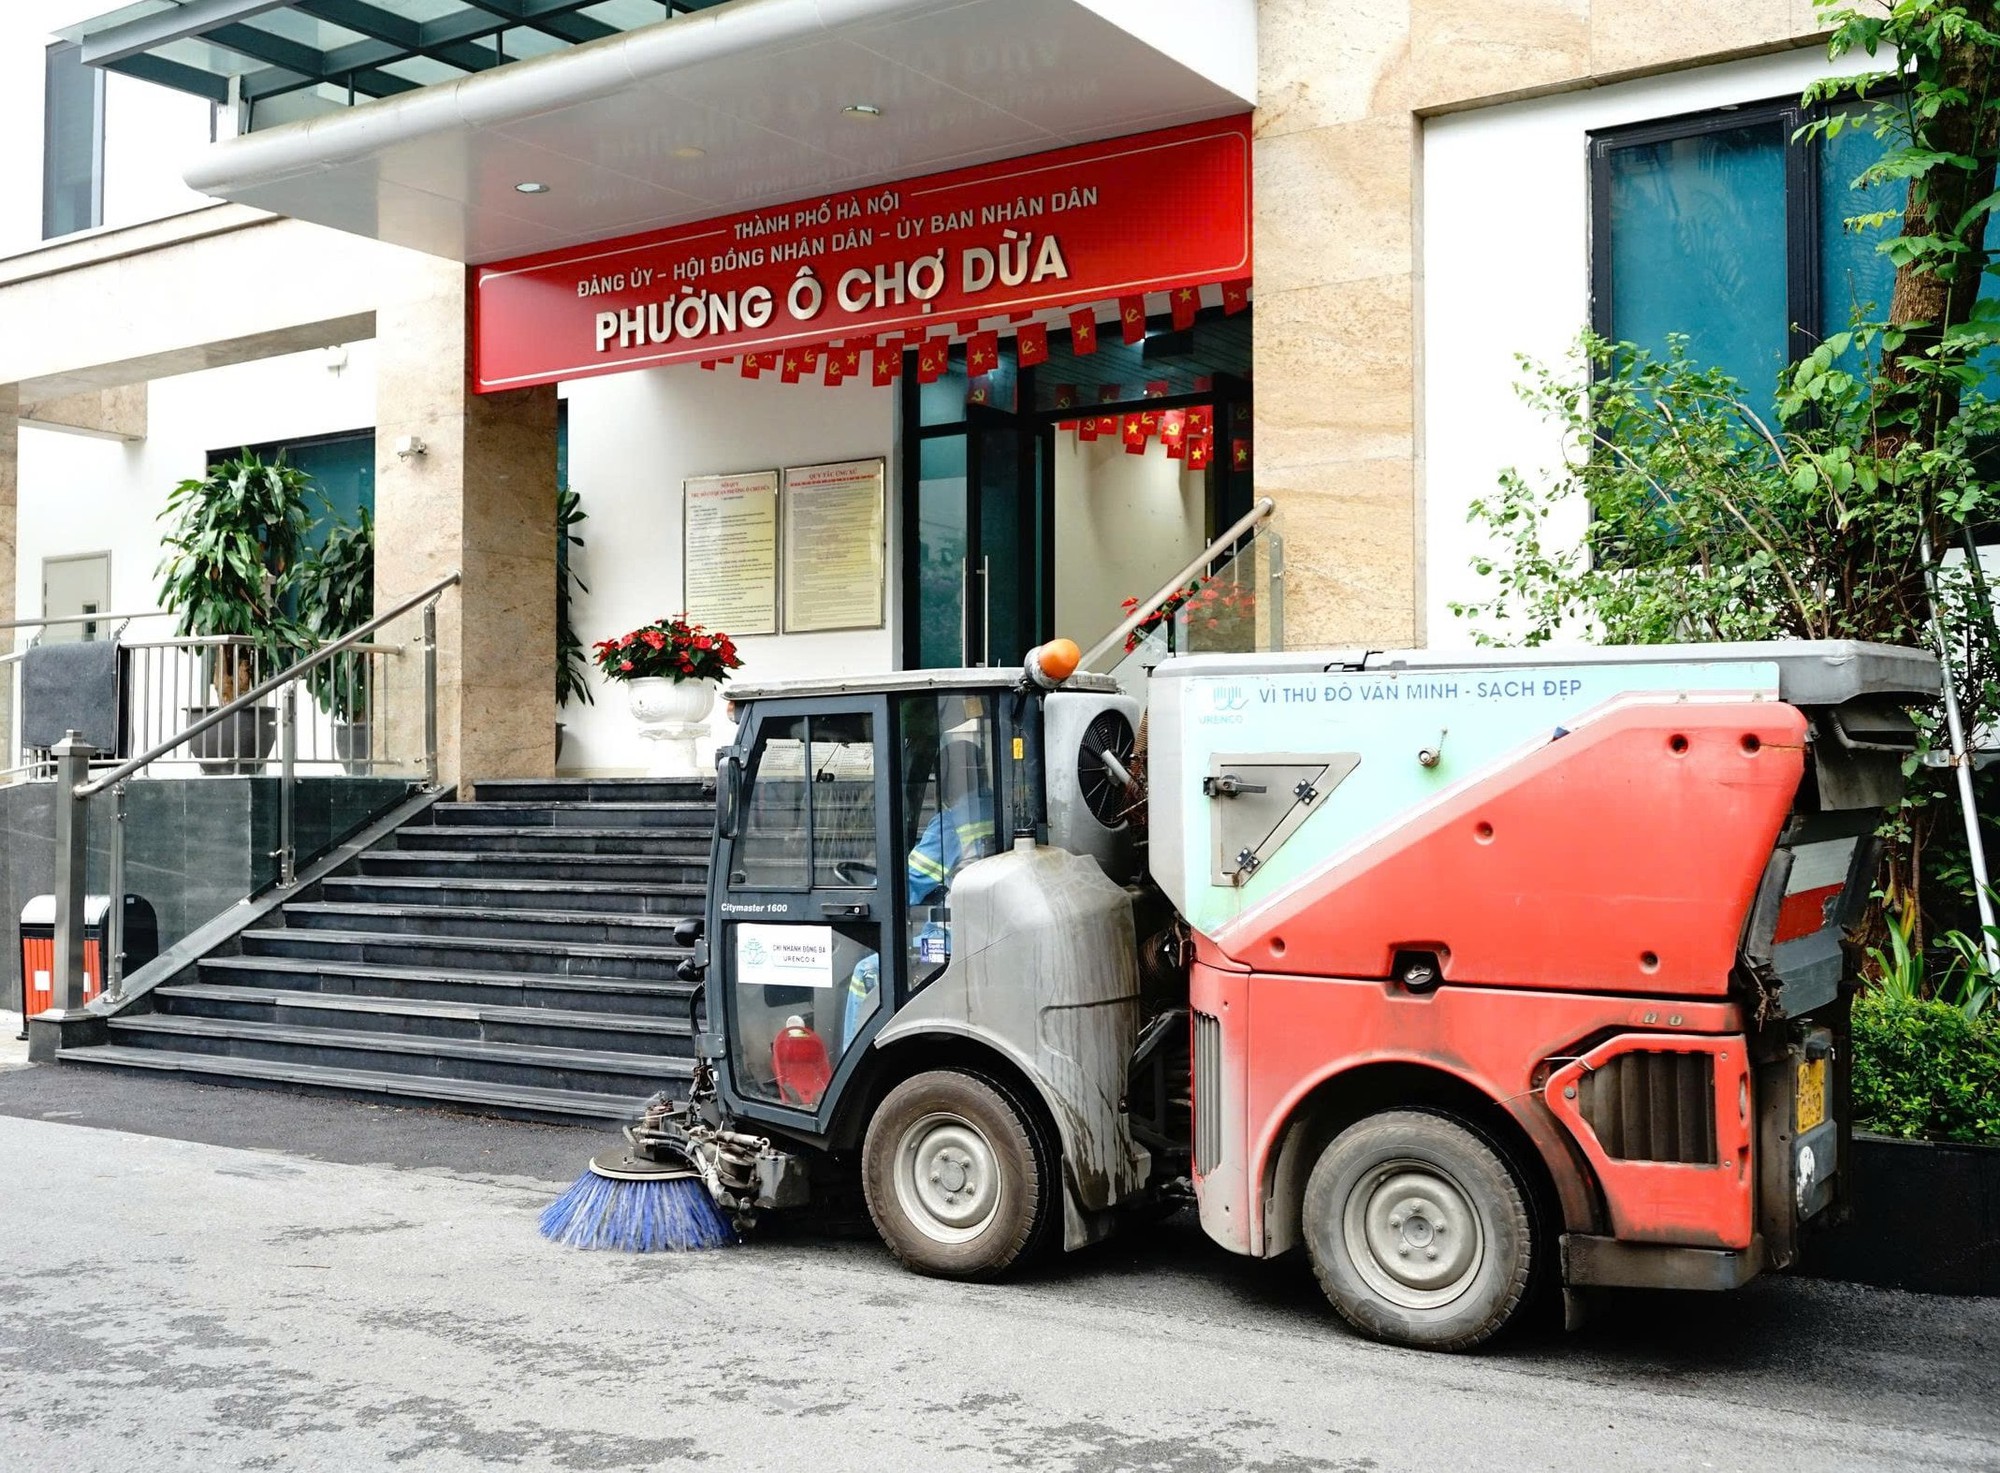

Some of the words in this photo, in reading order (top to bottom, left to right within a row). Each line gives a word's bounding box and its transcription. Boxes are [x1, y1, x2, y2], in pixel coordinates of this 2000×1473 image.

[734, 215, 789, 240] THÀNH
[795, 199, 831, 228] PHỐ
[837, 196, 861, 220] HÀ
[867, 191, 899, 215] NỘI
[577, 274, 625, 297] ĐẢNG
[631, 267, 653, 288] ỦY
[674, 257, 704, 281] HỘI
[711, 247, 764, 274] ĐỒNG
[770, 237, 825, 263] NHÂN
[832, 228, 872, 252] DÂN
[897, 216, 924, 240] ỦY
[931, 209, 974, 234] BAN
[982, 196, 1043, 225] NHÂN
[1052, 186, 1098, 212] DÂN
[595, 285, 773, 352] PHƯỜNG
[787, 265, 822, 320] Ô
[837, 248, 944, 313] CHỢ
[963, 228, 1068, 293] DỪA
[1324, 682, 1352, 702] ĐÔ
[1360, 681, 1399, 701] VĂN
[1407, 683, 1458, 700] MINH
[1477, 681, 1535, 702] SẠCH
[1543, 679, 1582, 701] ĐẸP
[1198, 714, 1244, 725] URENCO
[721, 903, 765, 913] Citymaster
[767, 904, 788, 913] 1600
[783, 955, 810, 963] URENCO
